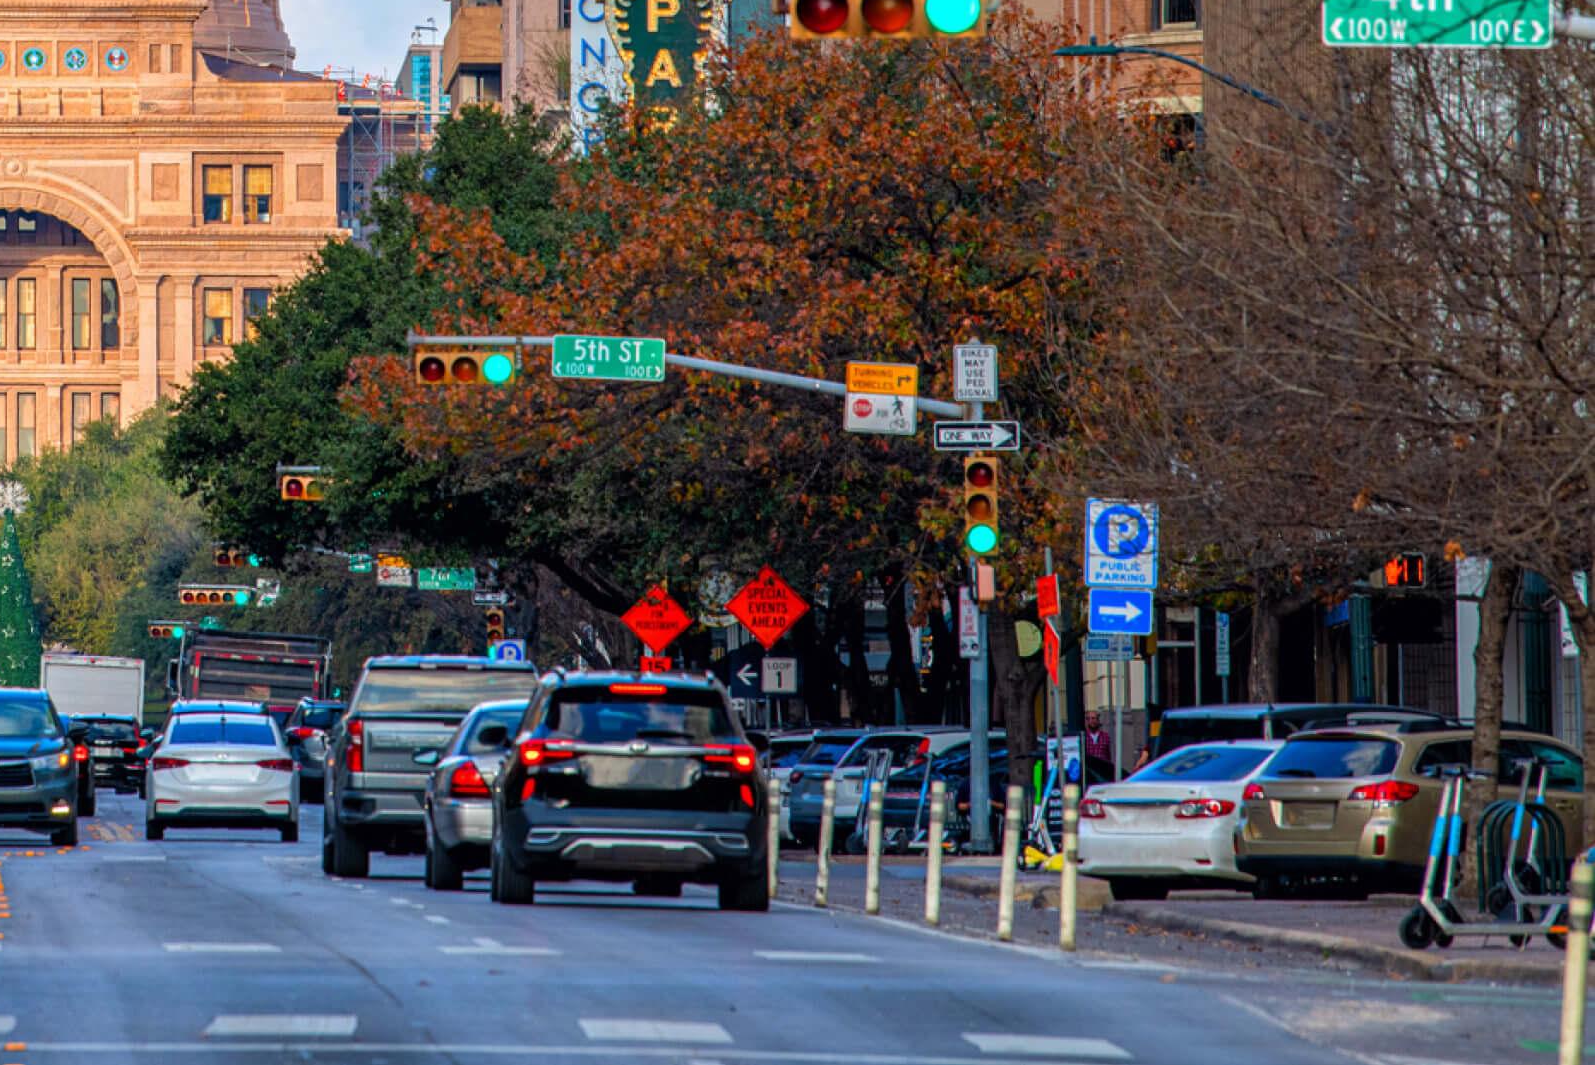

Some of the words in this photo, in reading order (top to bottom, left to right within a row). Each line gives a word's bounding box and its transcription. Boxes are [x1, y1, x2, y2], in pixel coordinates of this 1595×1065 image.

[1349, 18, 1407, 41] 100W
[1471, 19, 1525, 43] 100E
[574, 339, 610, 362] 5th
[618, 340, 644, 363] ST
[965, 359, 984, 367] MAY
[566, 363, 595, 375] 100W
[625, 366, 653, 377] 100E
[965, 369, 984, 377] USE
[966, 379, 986, 387] PED
[944, 431, 964, 440] ONE
[971, 431, 992, 440] WAY
[1099, 561, 1142, 572] PUBLIC
[1095, 572, 1147, 583] PARKING
[747, 587, 788, 600] SPECIAL
[748, 602, 788, 614] EVENTS
[751, 617, 786, 628] AHEAD
[766, 662, 791, 670] LOOP
[776, 671, 782, 688] 1
